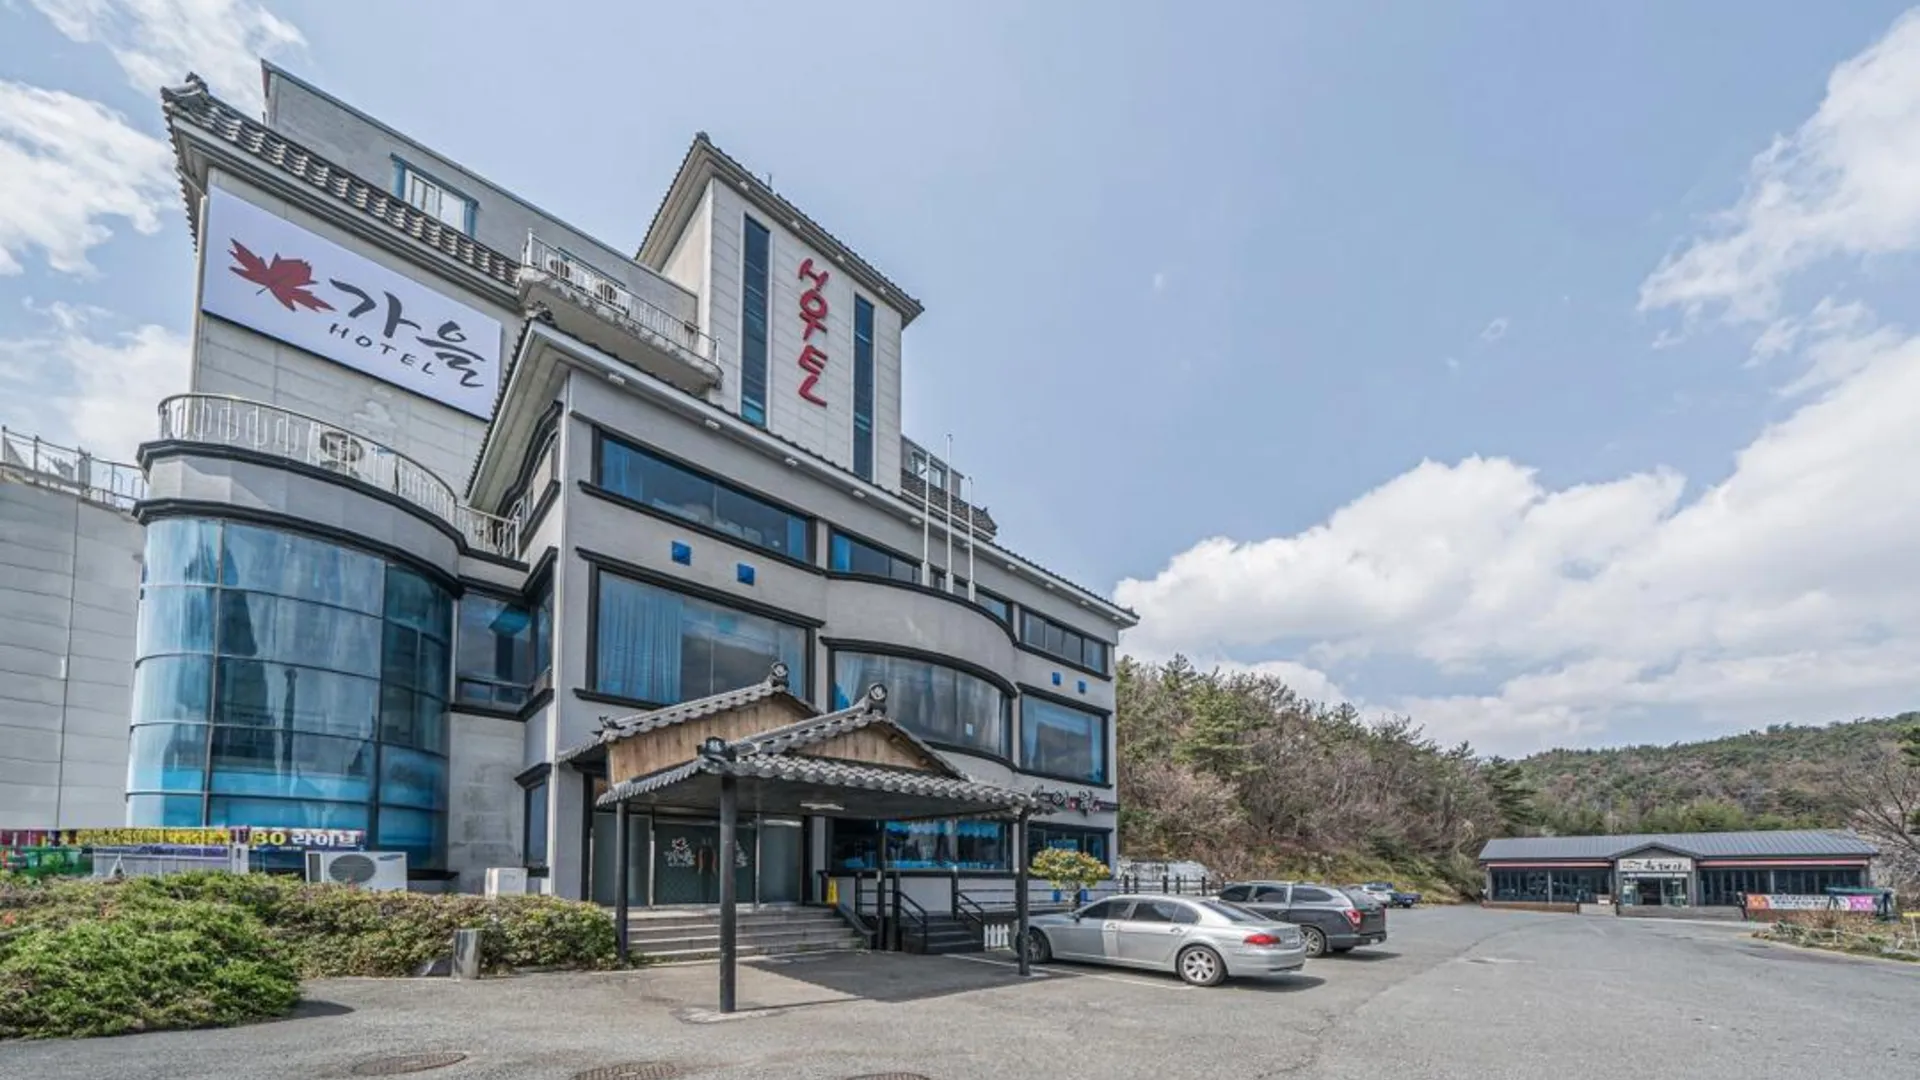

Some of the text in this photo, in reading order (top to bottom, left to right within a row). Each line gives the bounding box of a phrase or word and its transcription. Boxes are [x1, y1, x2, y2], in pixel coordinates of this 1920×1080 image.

[329, 278, 486, 388] 가을
[329, 322, 436, 376] HOTEL
[798, 258, 829, 408] HOTEL
[291, 831, 358, 847] 라이브
